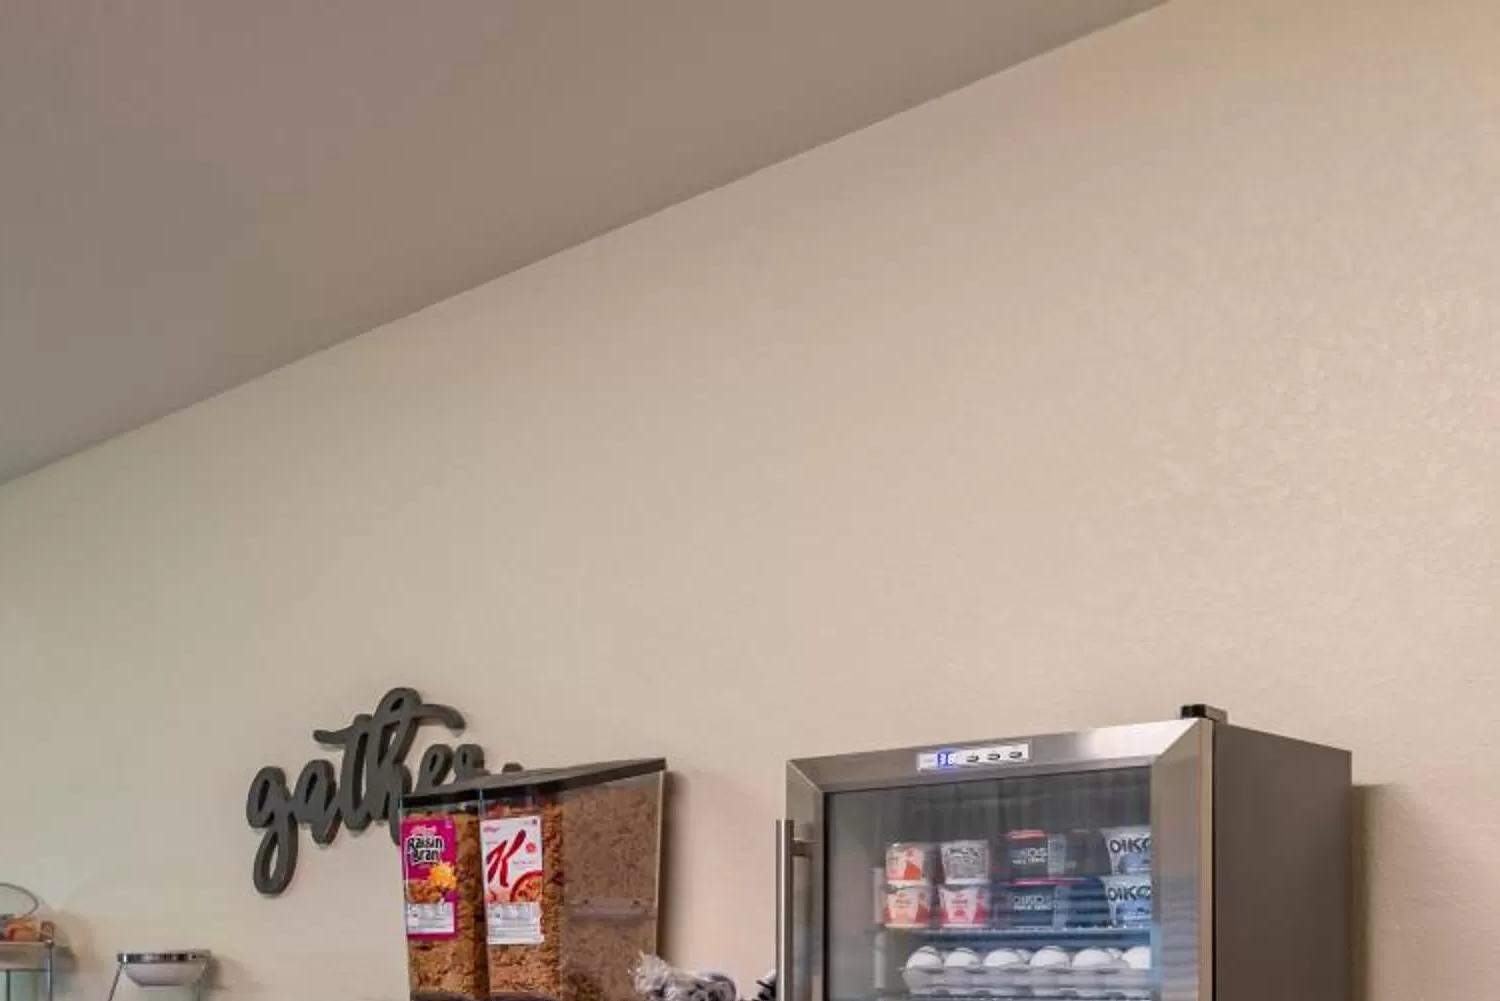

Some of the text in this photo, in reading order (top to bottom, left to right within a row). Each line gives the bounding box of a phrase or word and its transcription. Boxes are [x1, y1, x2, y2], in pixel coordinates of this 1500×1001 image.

[407, 836, 443, 852] Raisin
[412, 849, 439, 863] Bran
[486, 829, 526, 888] K
